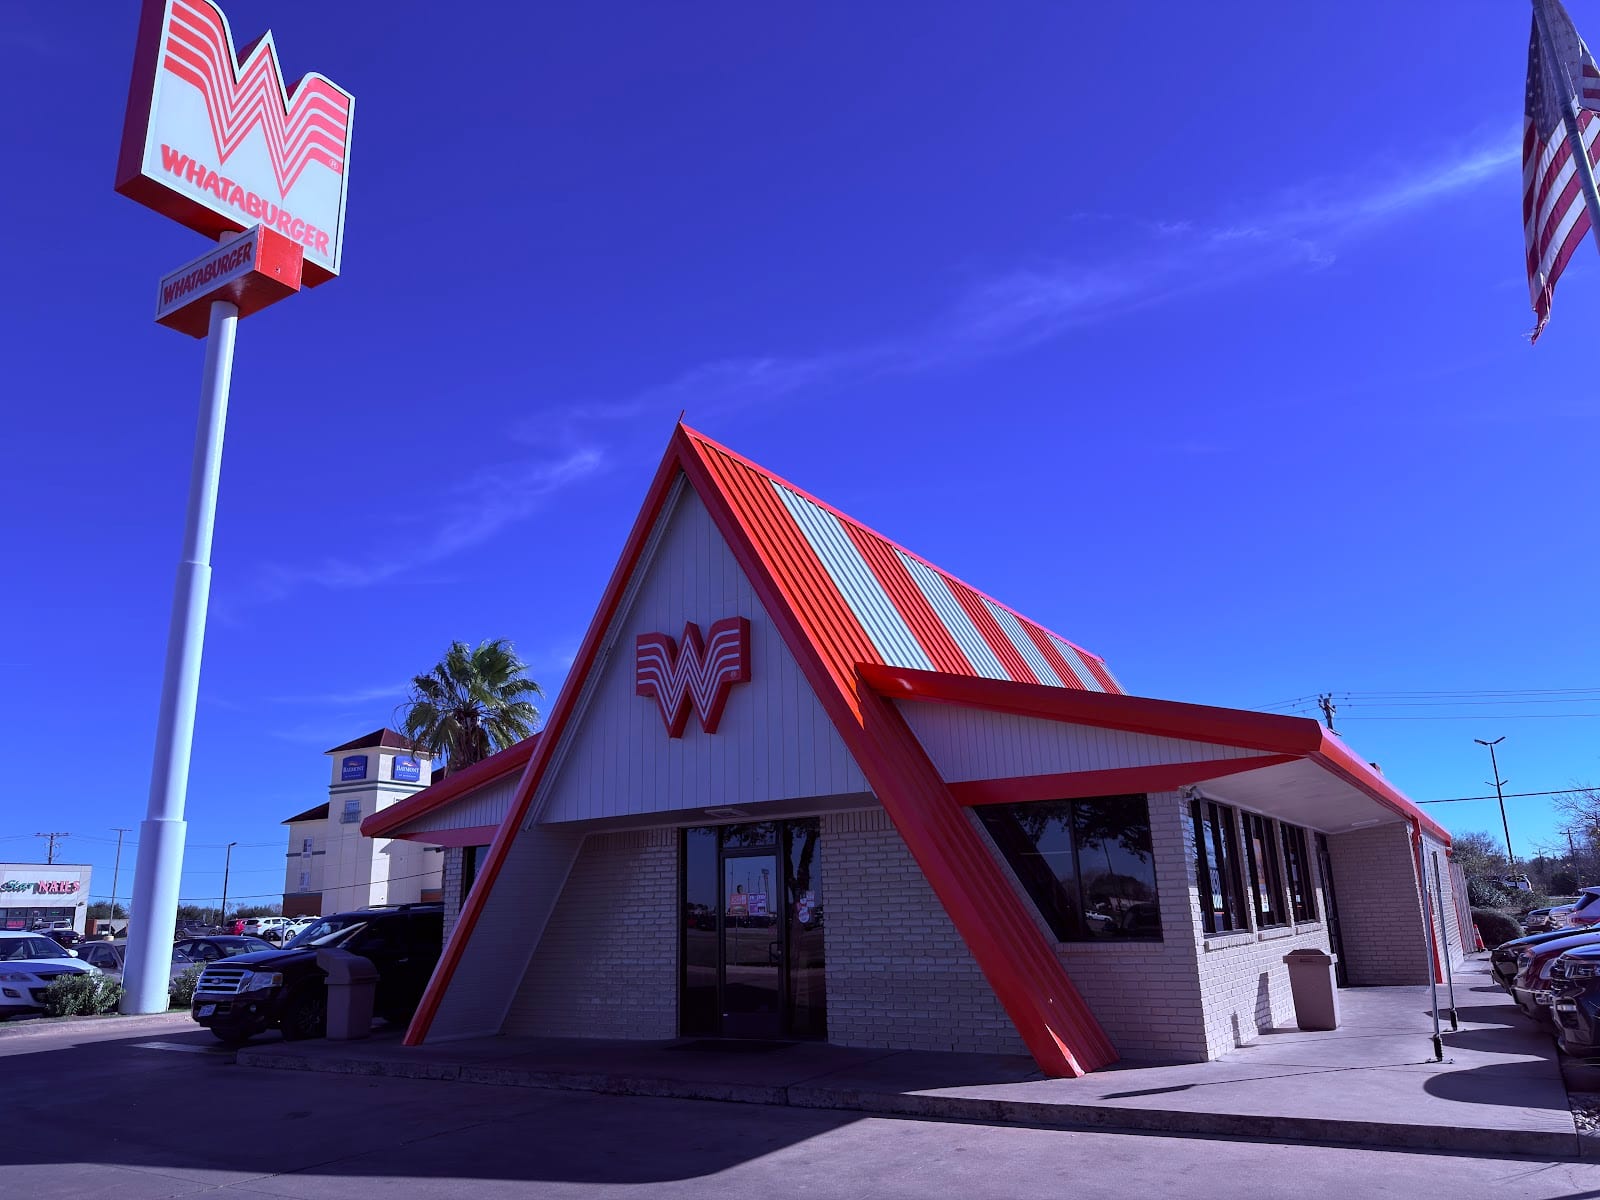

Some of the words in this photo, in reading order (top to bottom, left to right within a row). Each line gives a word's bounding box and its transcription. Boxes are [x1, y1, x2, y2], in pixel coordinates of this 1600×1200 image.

[160, 143, 330, 257] WHATABURGER
[162, 241, 253, 305] WHATABURGER
[38, 880, 81, 894] NAILS
